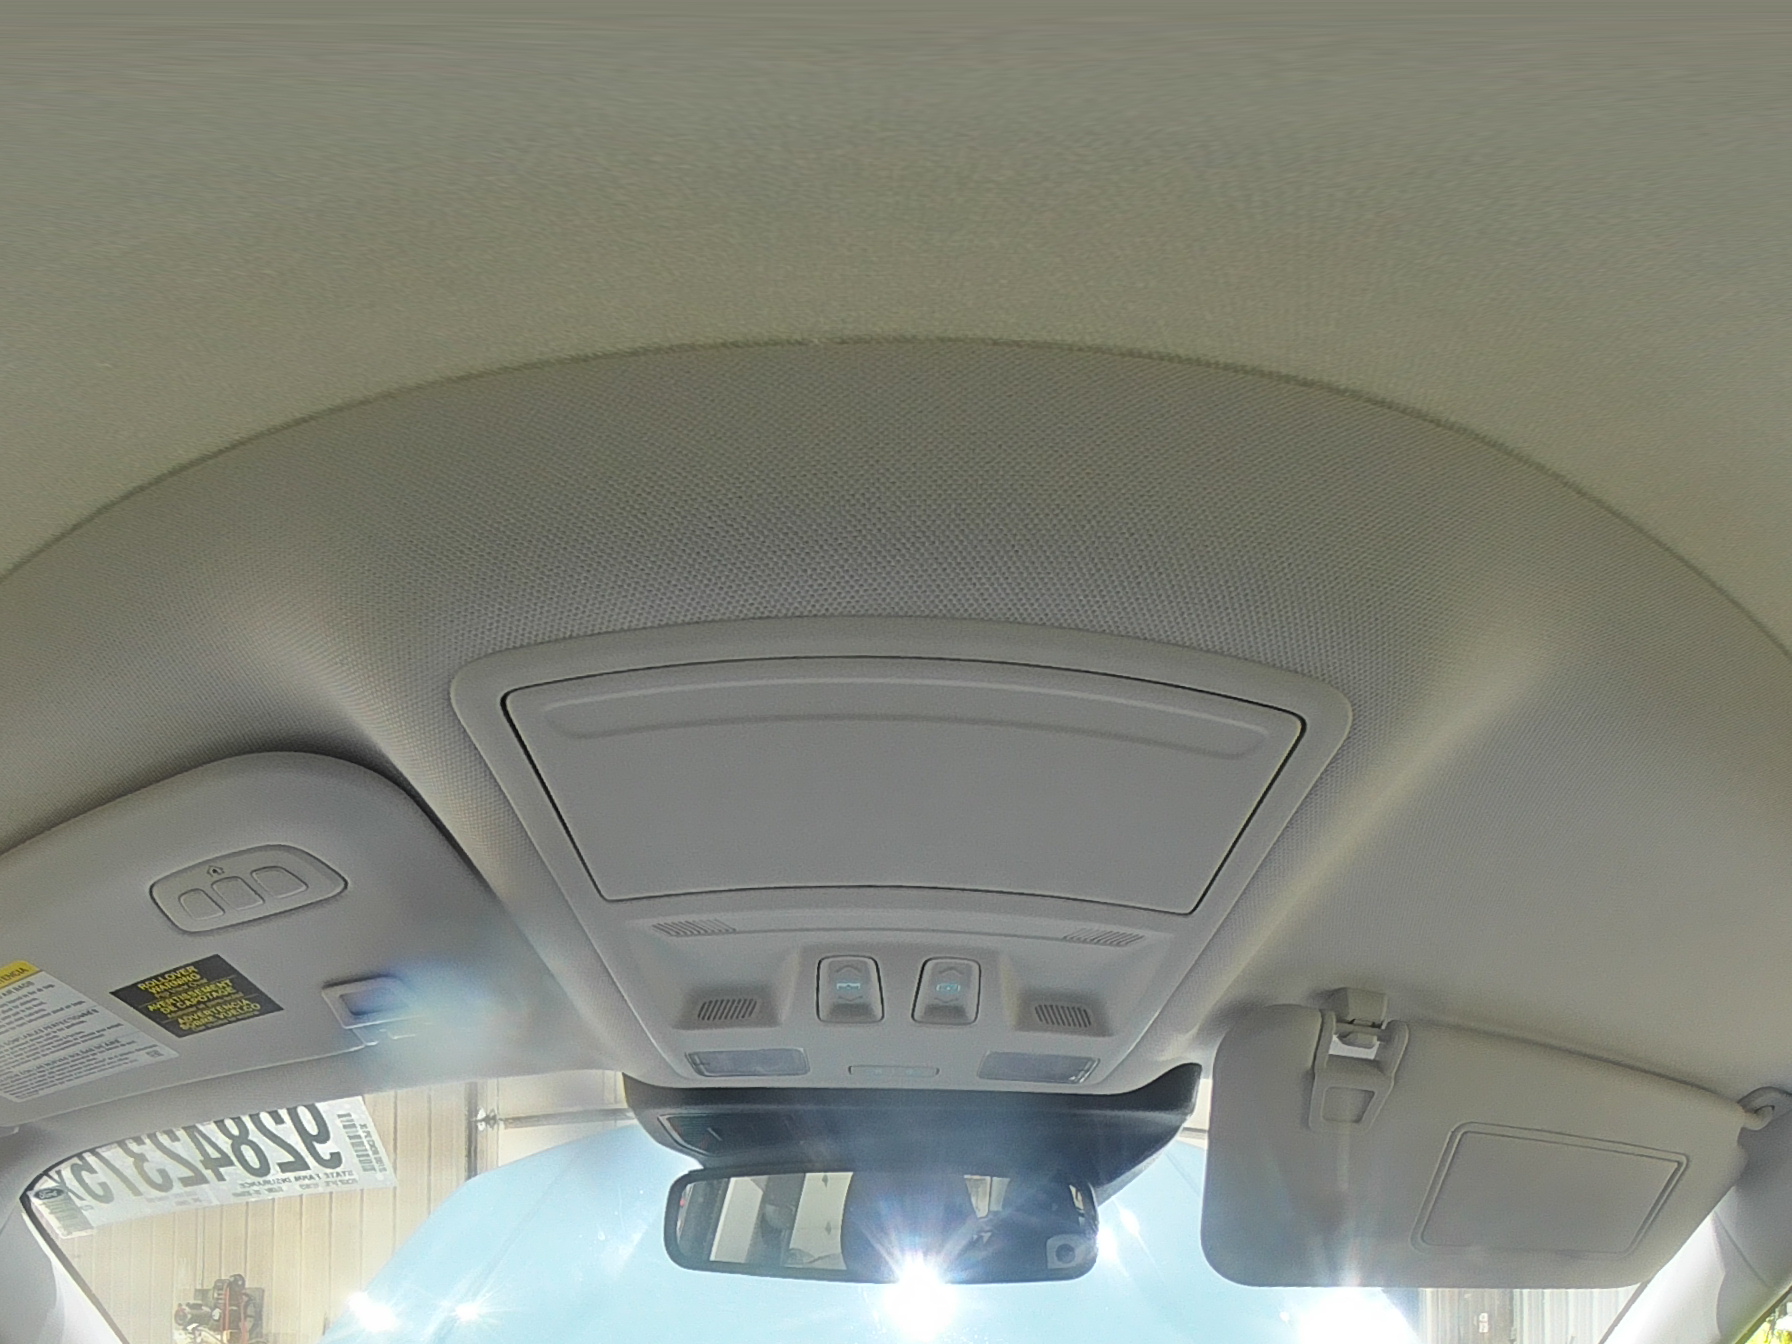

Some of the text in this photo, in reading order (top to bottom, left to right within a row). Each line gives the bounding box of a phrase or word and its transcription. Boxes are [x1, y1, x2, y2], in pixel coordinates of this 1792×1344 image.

[137, 965, 198, 991] ROLLOVER
[147, 979, 233, 1012] AVERTISSEMENT
[160, 1004, 176, 1014] DE
[177, 998, 252, 1025] ADVERTENCIA
[216, 1003, 261, 1020] VUELCO
